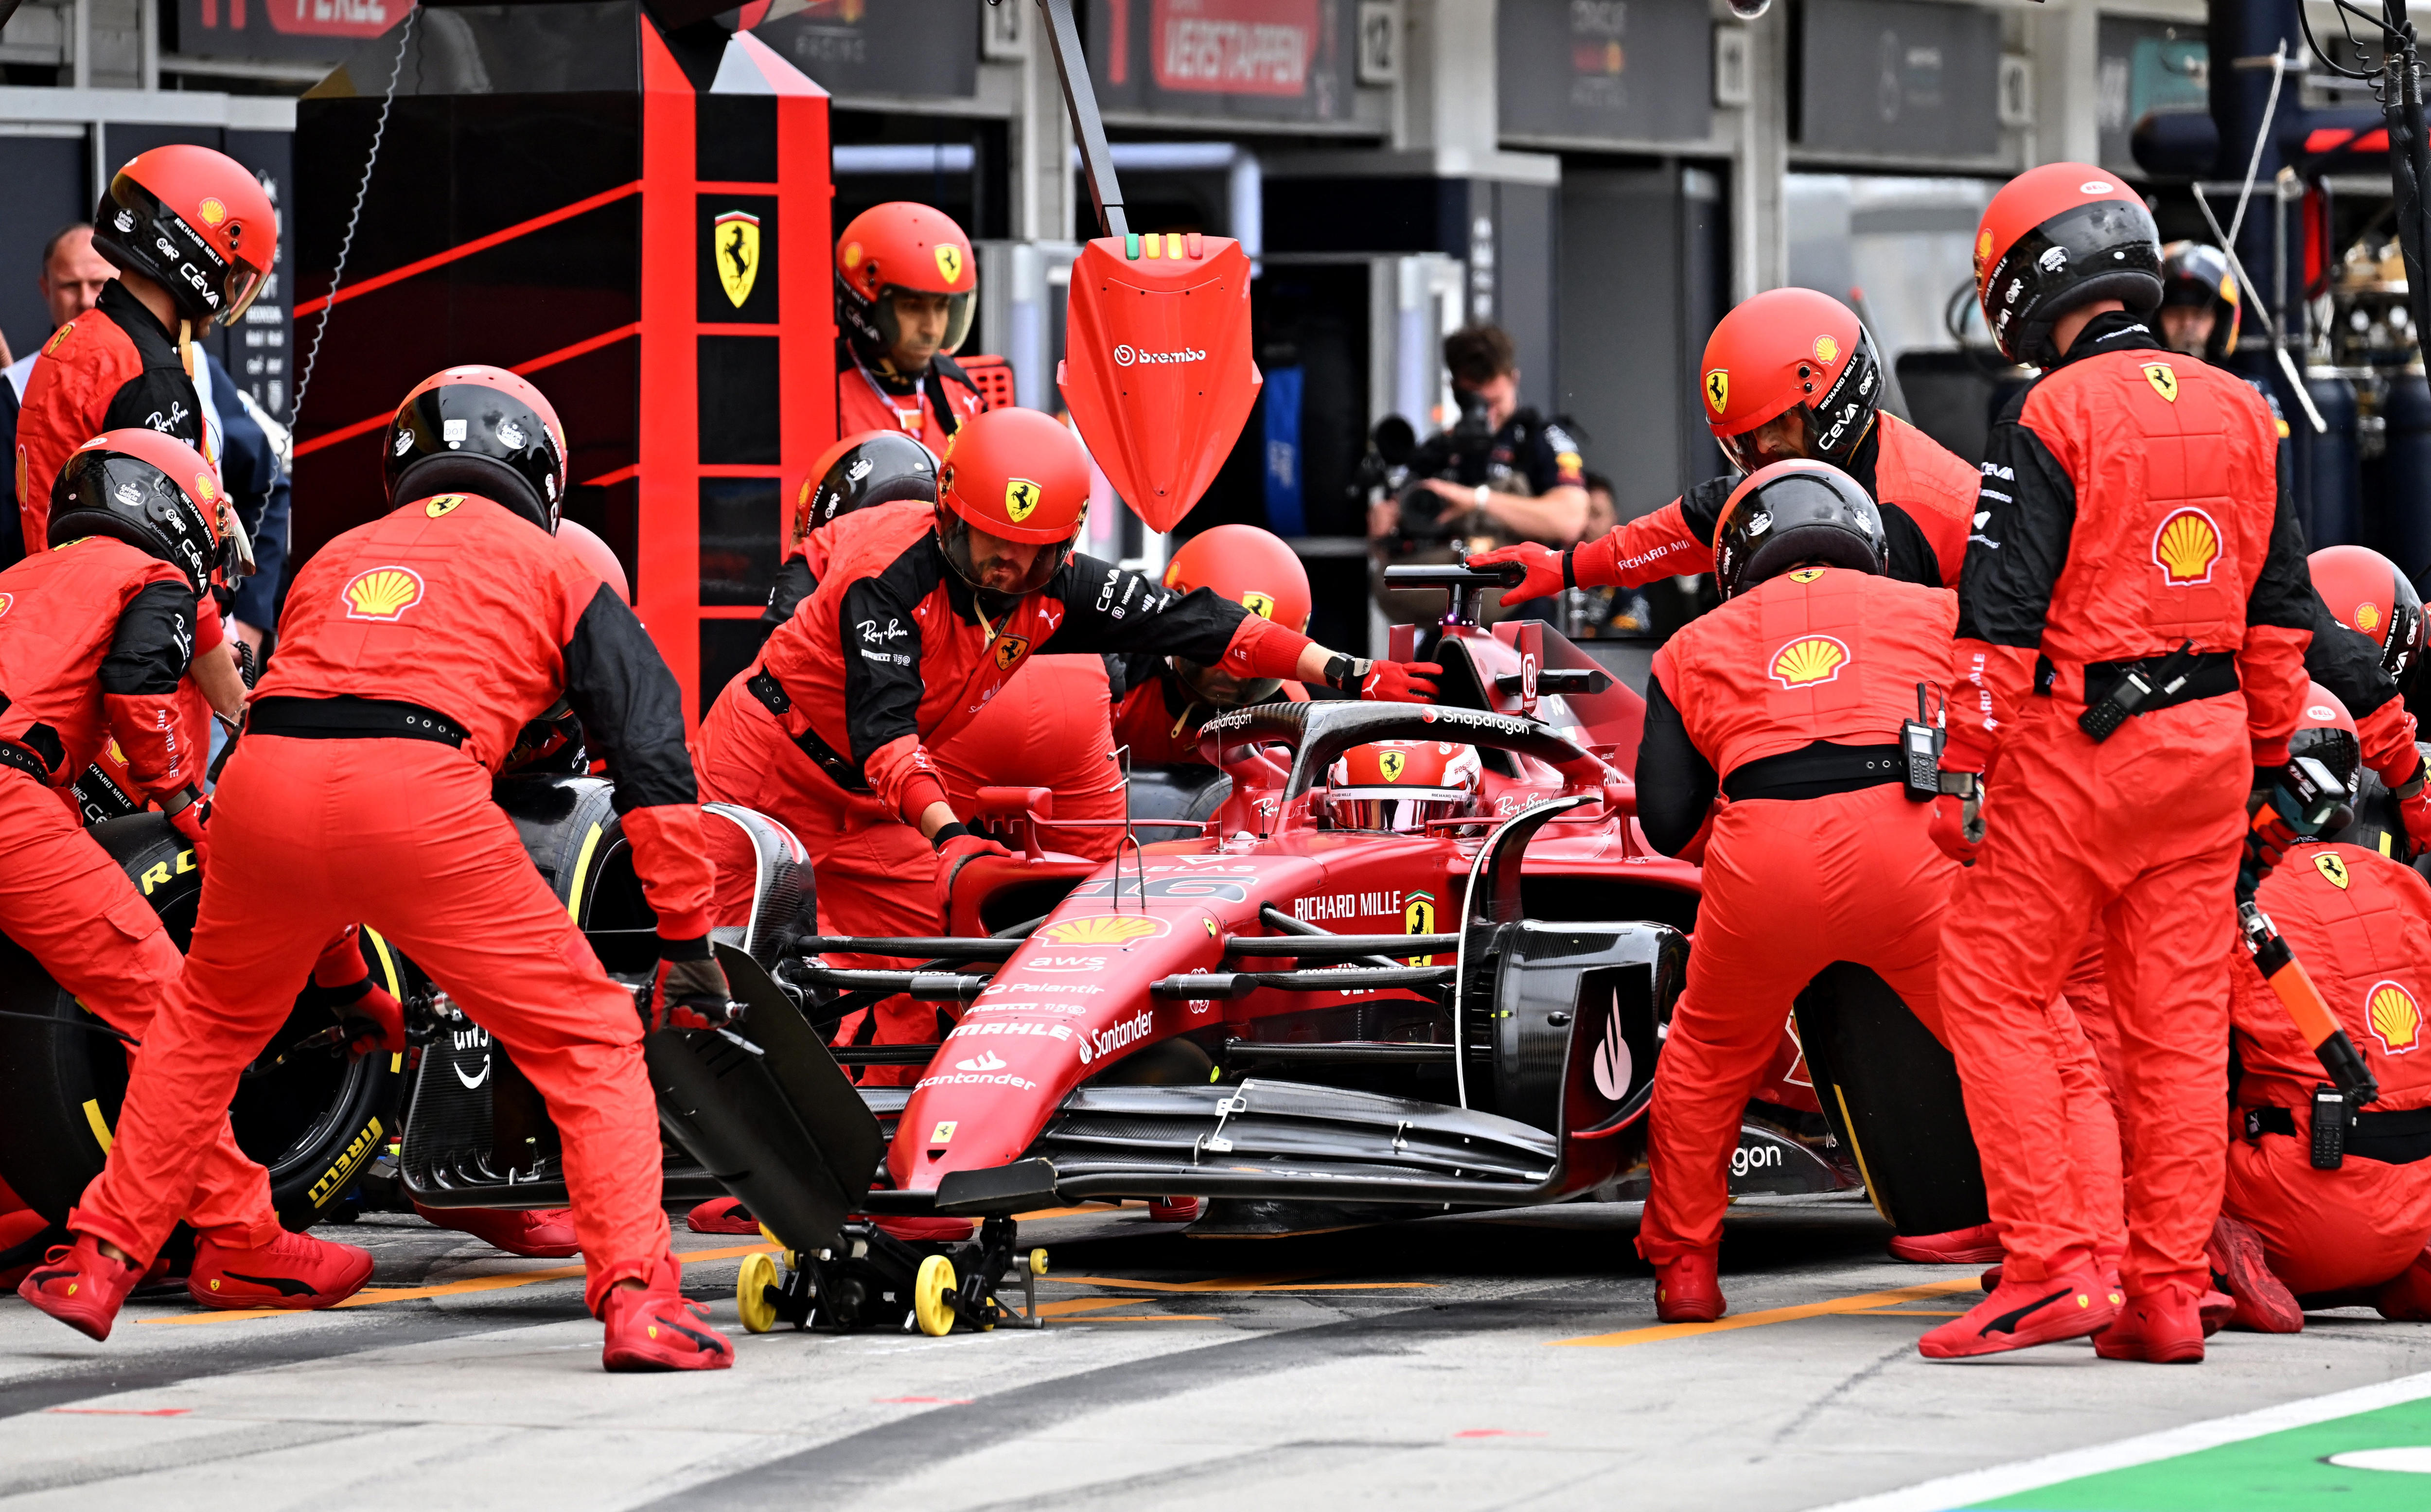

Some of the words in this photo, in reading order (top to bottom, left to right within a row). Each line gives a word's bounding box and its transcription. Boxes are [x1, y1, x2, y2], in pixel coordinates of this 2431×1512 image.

[174, 217, 205, 248] RICHARD
[204, 246, 224, 267] MILLE
[1992, 256, 2008, 280] MILLE
[1139, 347, 1206, 364] brembo
[1820, 377, 1845, 410] RICHARD
[1844, 354, 1858, 378] MILLE
[119, 489, 138, 501] Galicia
[120, 484, 141, 499] Estrella
[811, 485, 824, 508] MILLE
[149, 522, 168, 542] FALCONI
[180, 492, 205, 527] RICHARD
[204, 524, 216, 551] MILLE
[1618, 545, 1668, 571] RCHARD
[2390, 608, 2399, 634] MILLE
[2391, 651, 2409, 685] EVA
[157, 709, 176, 753] RICARD
[1443, 709, 1530, 735] Snapdragon
[88, 763, 113, 789] CHARD
[111, 788, 132, 809] MILLE
[1062, 875, 1260, 903] 16
[1294, 894, 1355, 921] RICHARD
[1360, 890, 1401, 917] MILLE
[1027, 956, 1109, 967] aws
[1008, 983, 1105, 996] Palantir
[964, 1002, 1039, 1017] PIRELLI
[945, 1022, 1074, 1042] MAHLE
[1093, 1009, 1154, 1059] Santander
[911, 1072, 1037, 1094] Santander
[307, 1116, 383, 1210] PIRELLI
